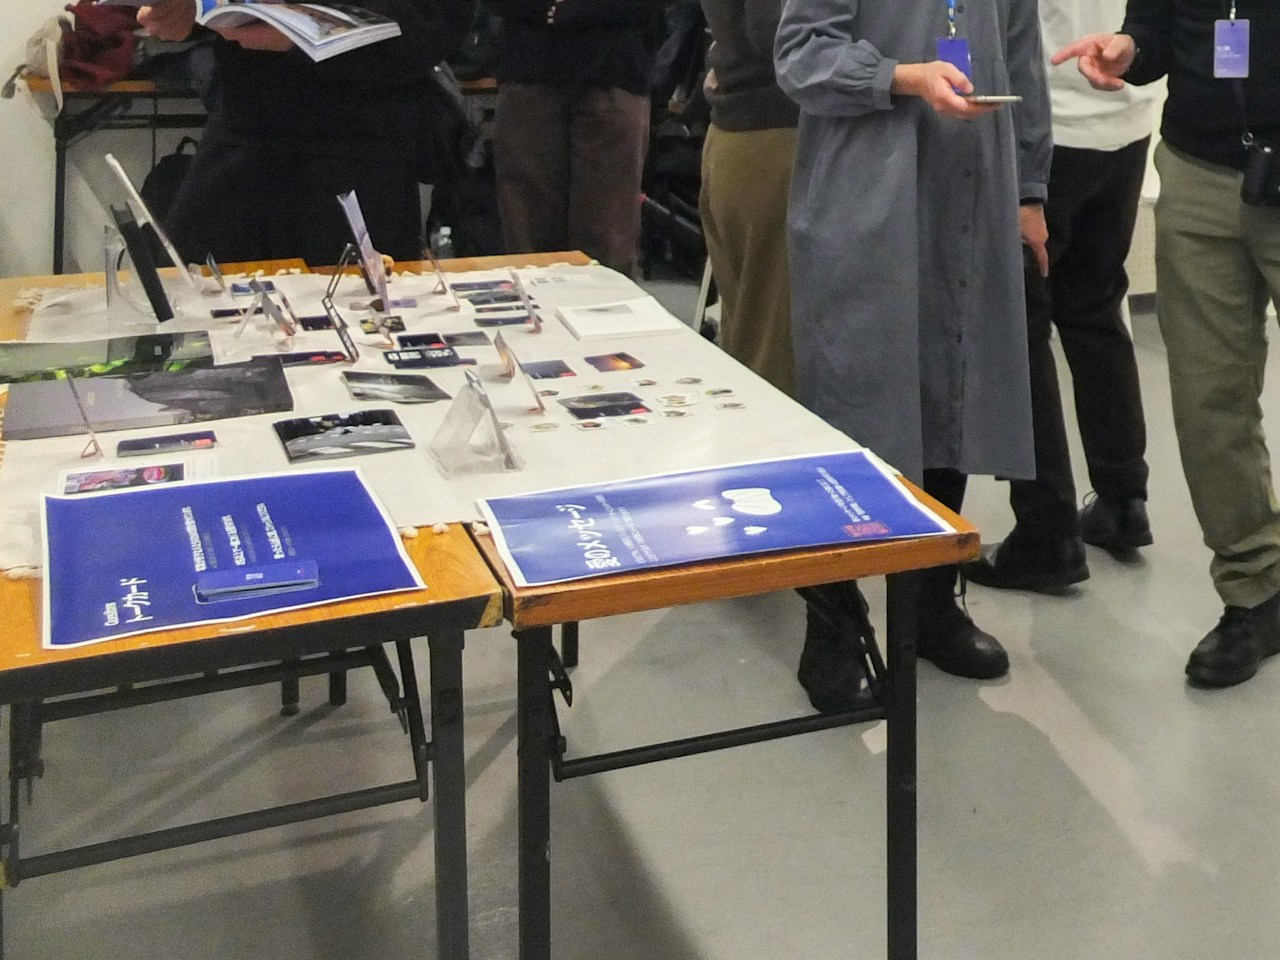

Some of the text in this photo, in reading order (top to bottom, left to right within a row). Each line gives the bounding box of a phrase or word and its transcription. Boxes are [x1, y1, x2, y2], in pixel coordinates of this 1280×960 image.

[555, 504, 621, 569] 愛のメッセージ
[120, 577, 153, 623] トークカード
